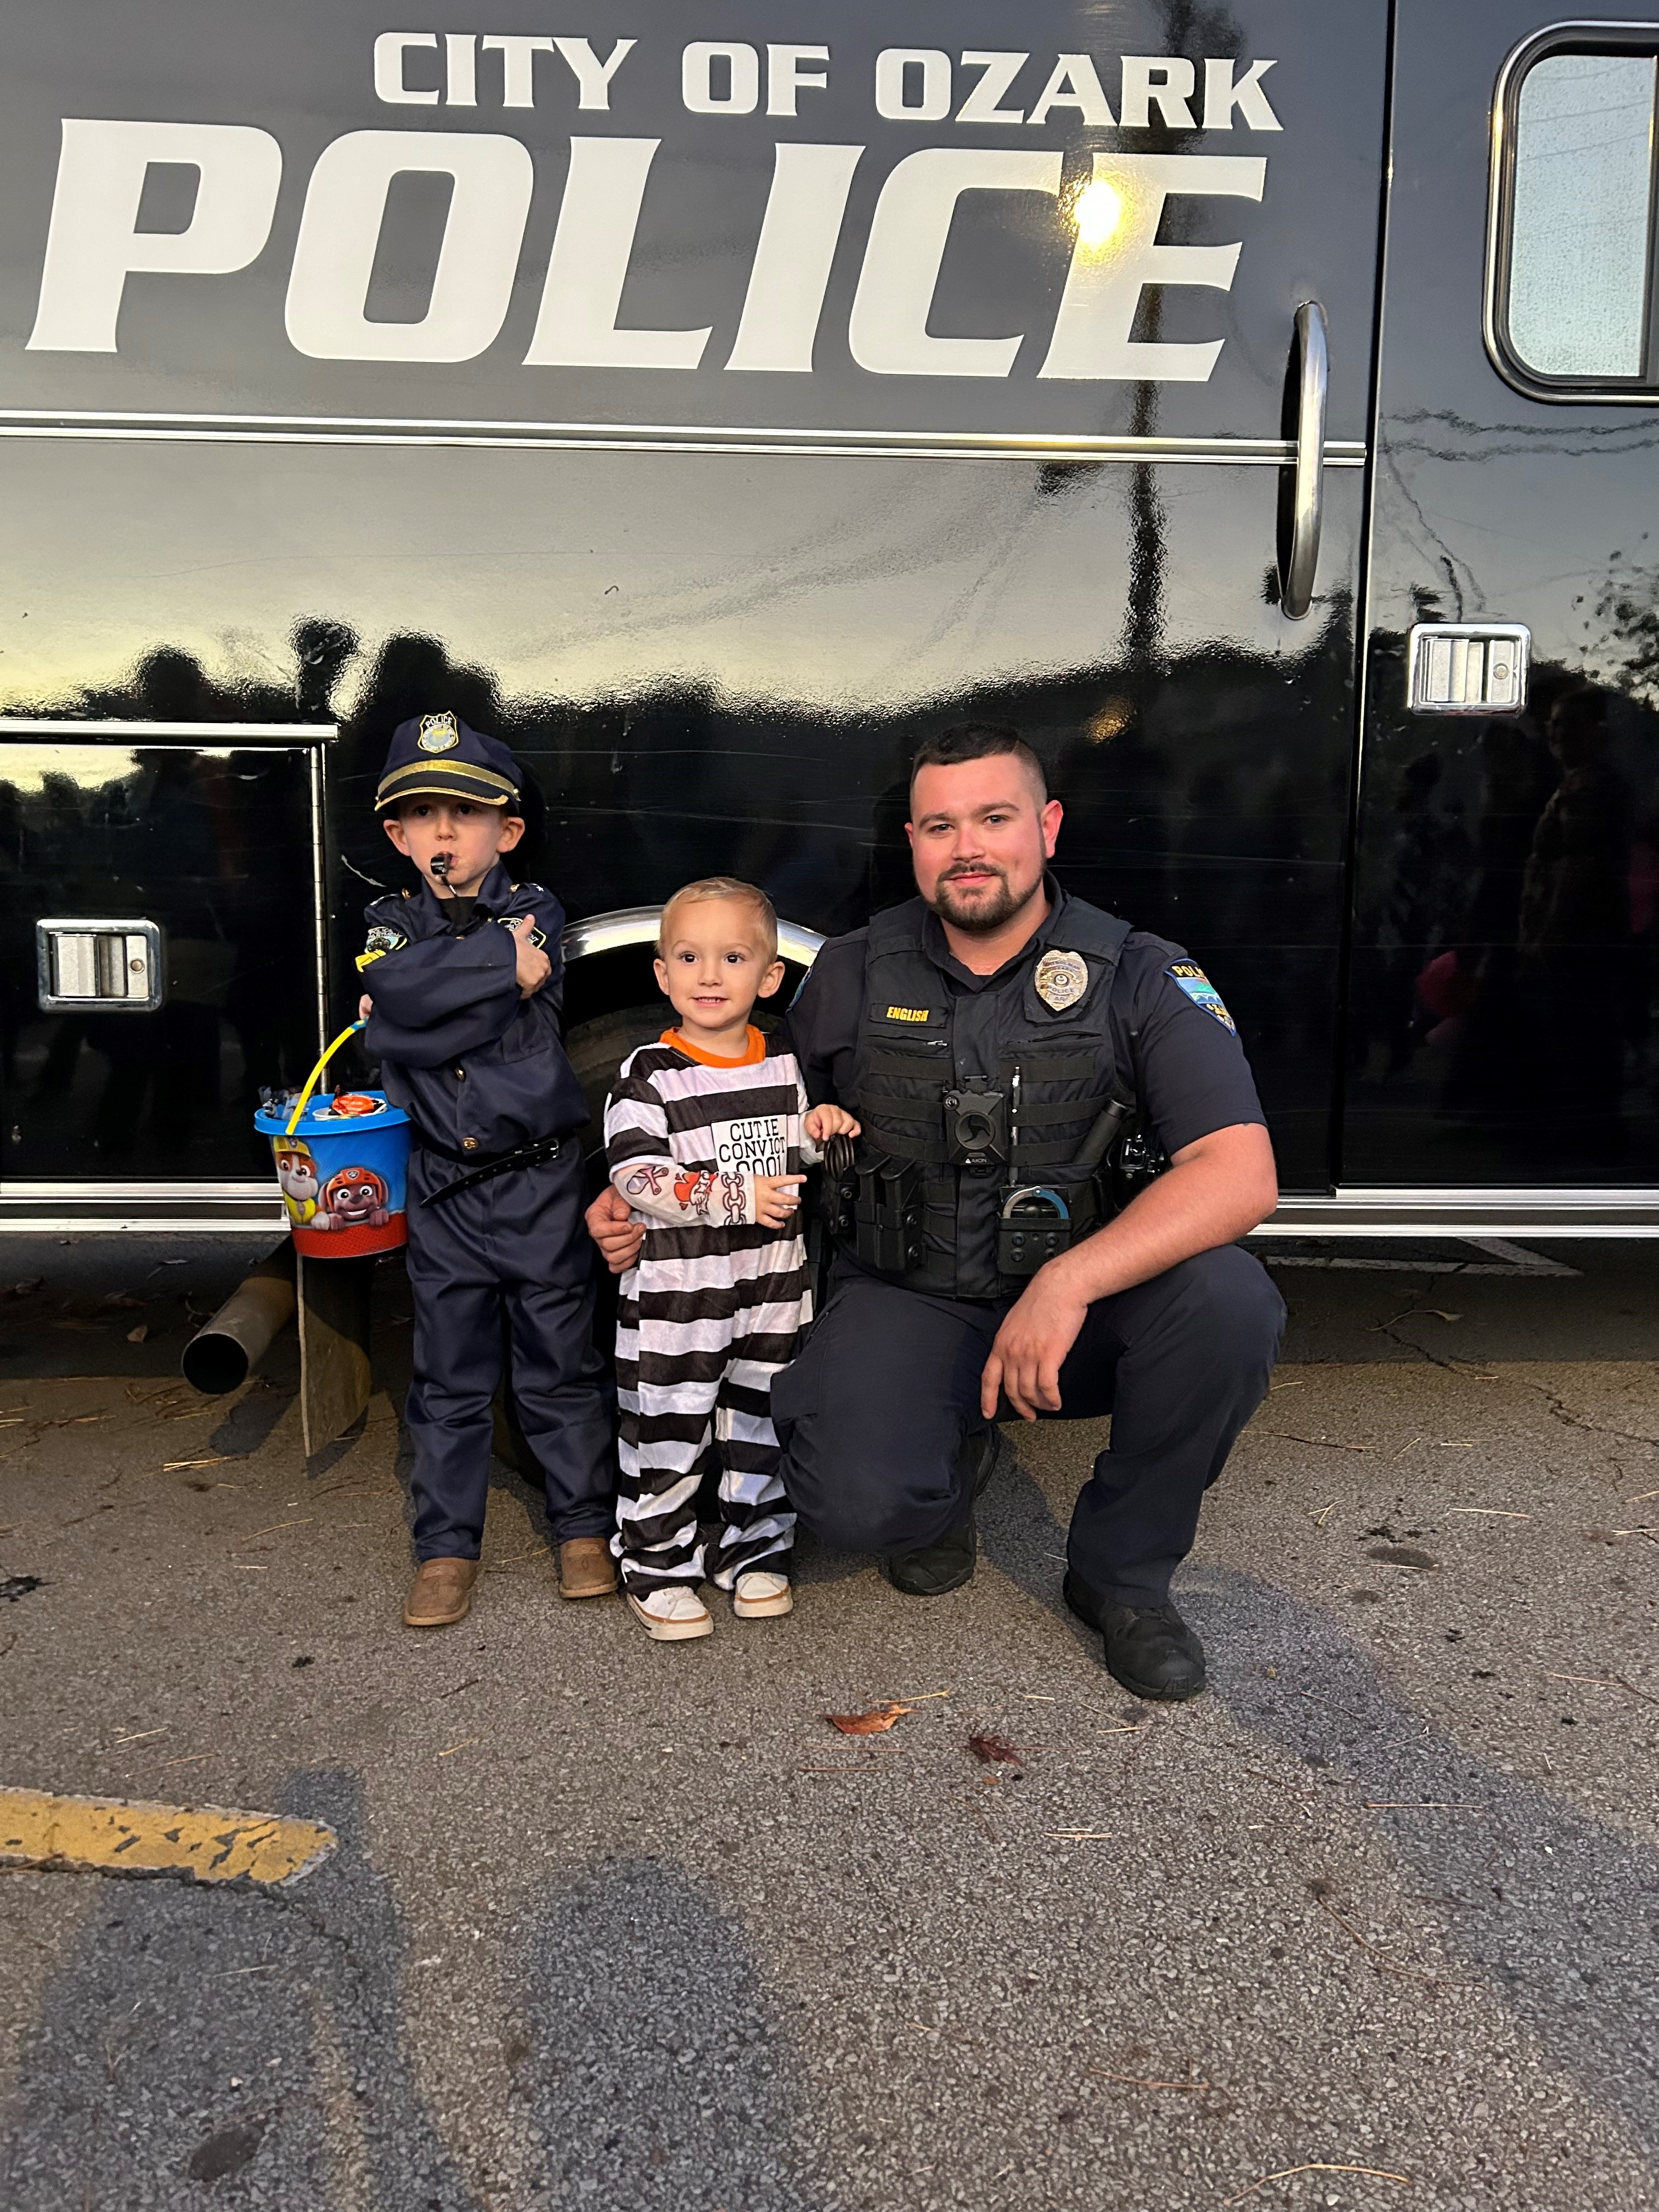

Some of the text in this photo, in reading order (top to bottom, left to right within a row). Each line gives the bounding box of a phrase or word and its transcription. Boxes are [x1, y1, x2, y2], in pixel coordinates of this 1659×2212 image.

[374, 32, 1284, 131] CITY OF OZARK
[25, 117, 1268, 382] POLICE
[425, 715, 453, 728] POLICE
[887, 1006, 929, 1022] ENGLISH
[730, 1119, 778, 1142] CUTIE
[719, 1137, 785, 1163] CONVICT
